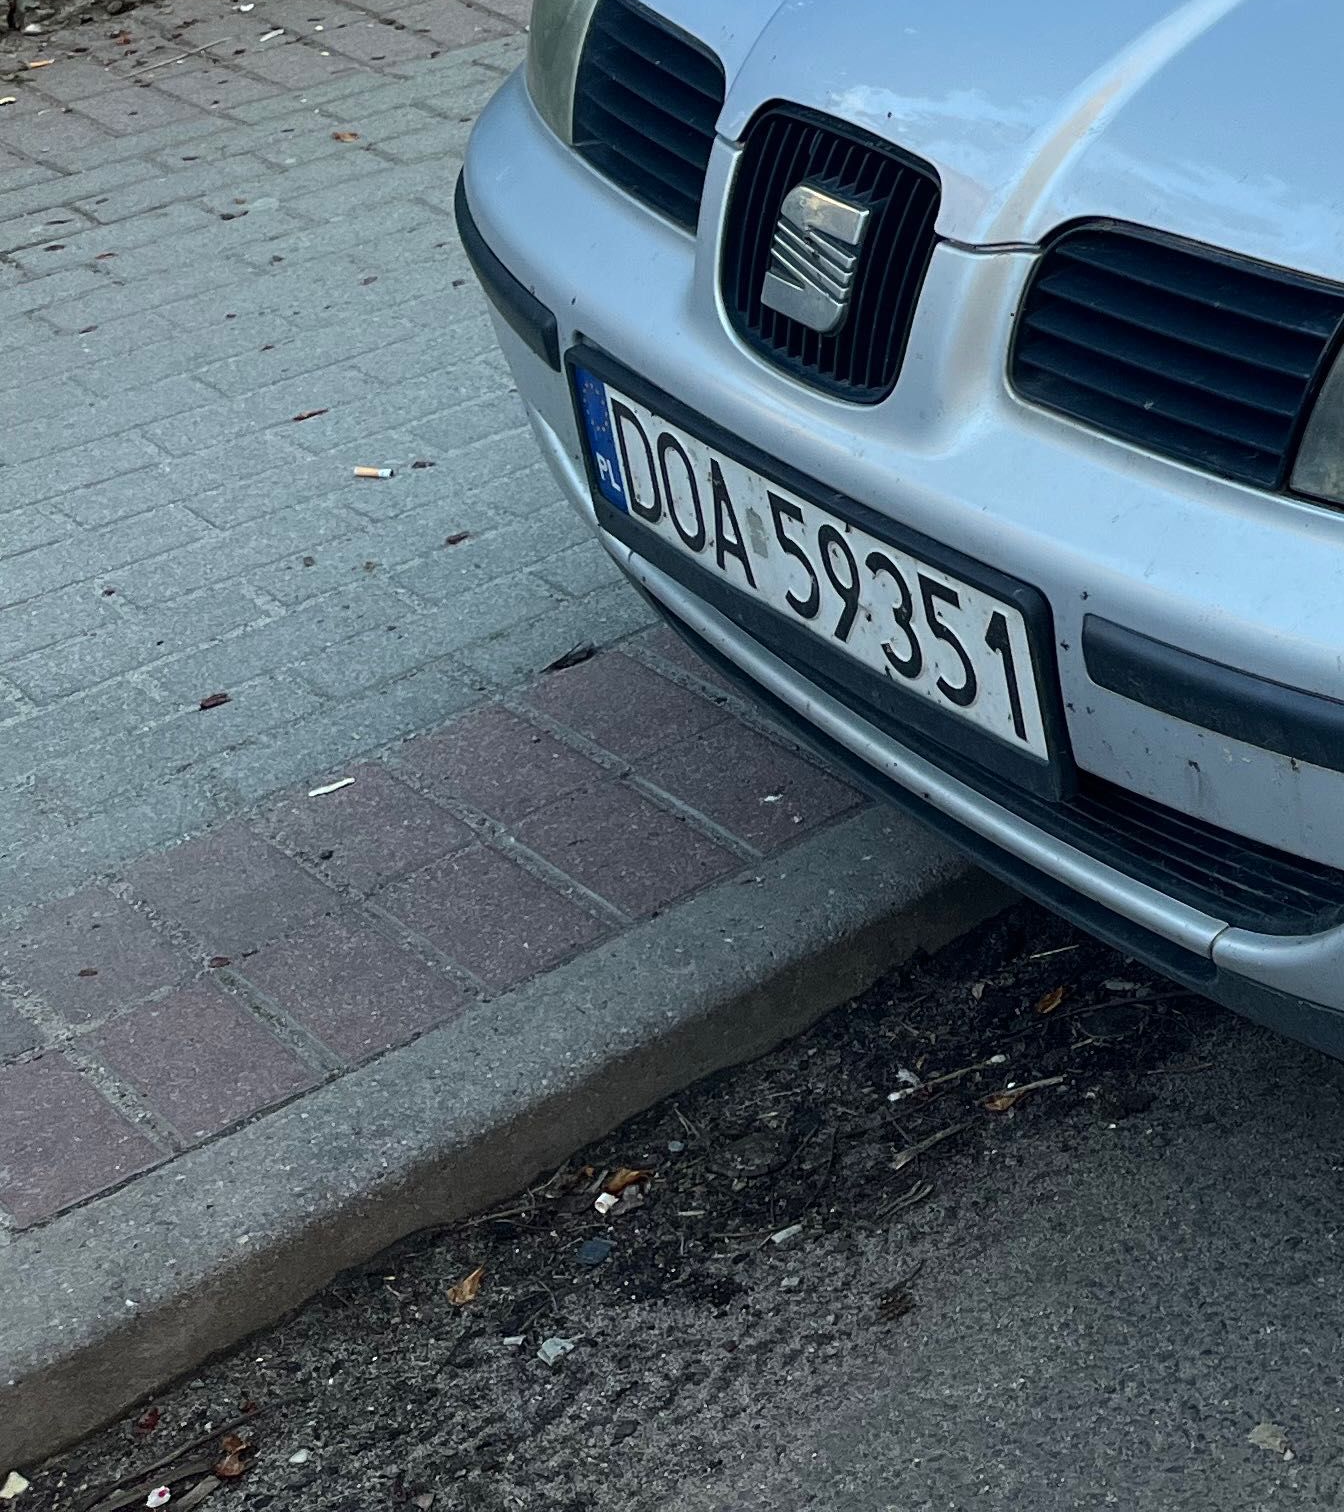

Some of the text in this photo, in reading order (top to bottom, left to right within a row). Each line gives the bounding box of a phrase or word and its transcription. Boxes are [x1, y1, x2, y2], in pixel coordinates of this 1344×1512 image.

[596, 451, 622, 493] PL
[611, 397, 1028, 743] DOA 59351
